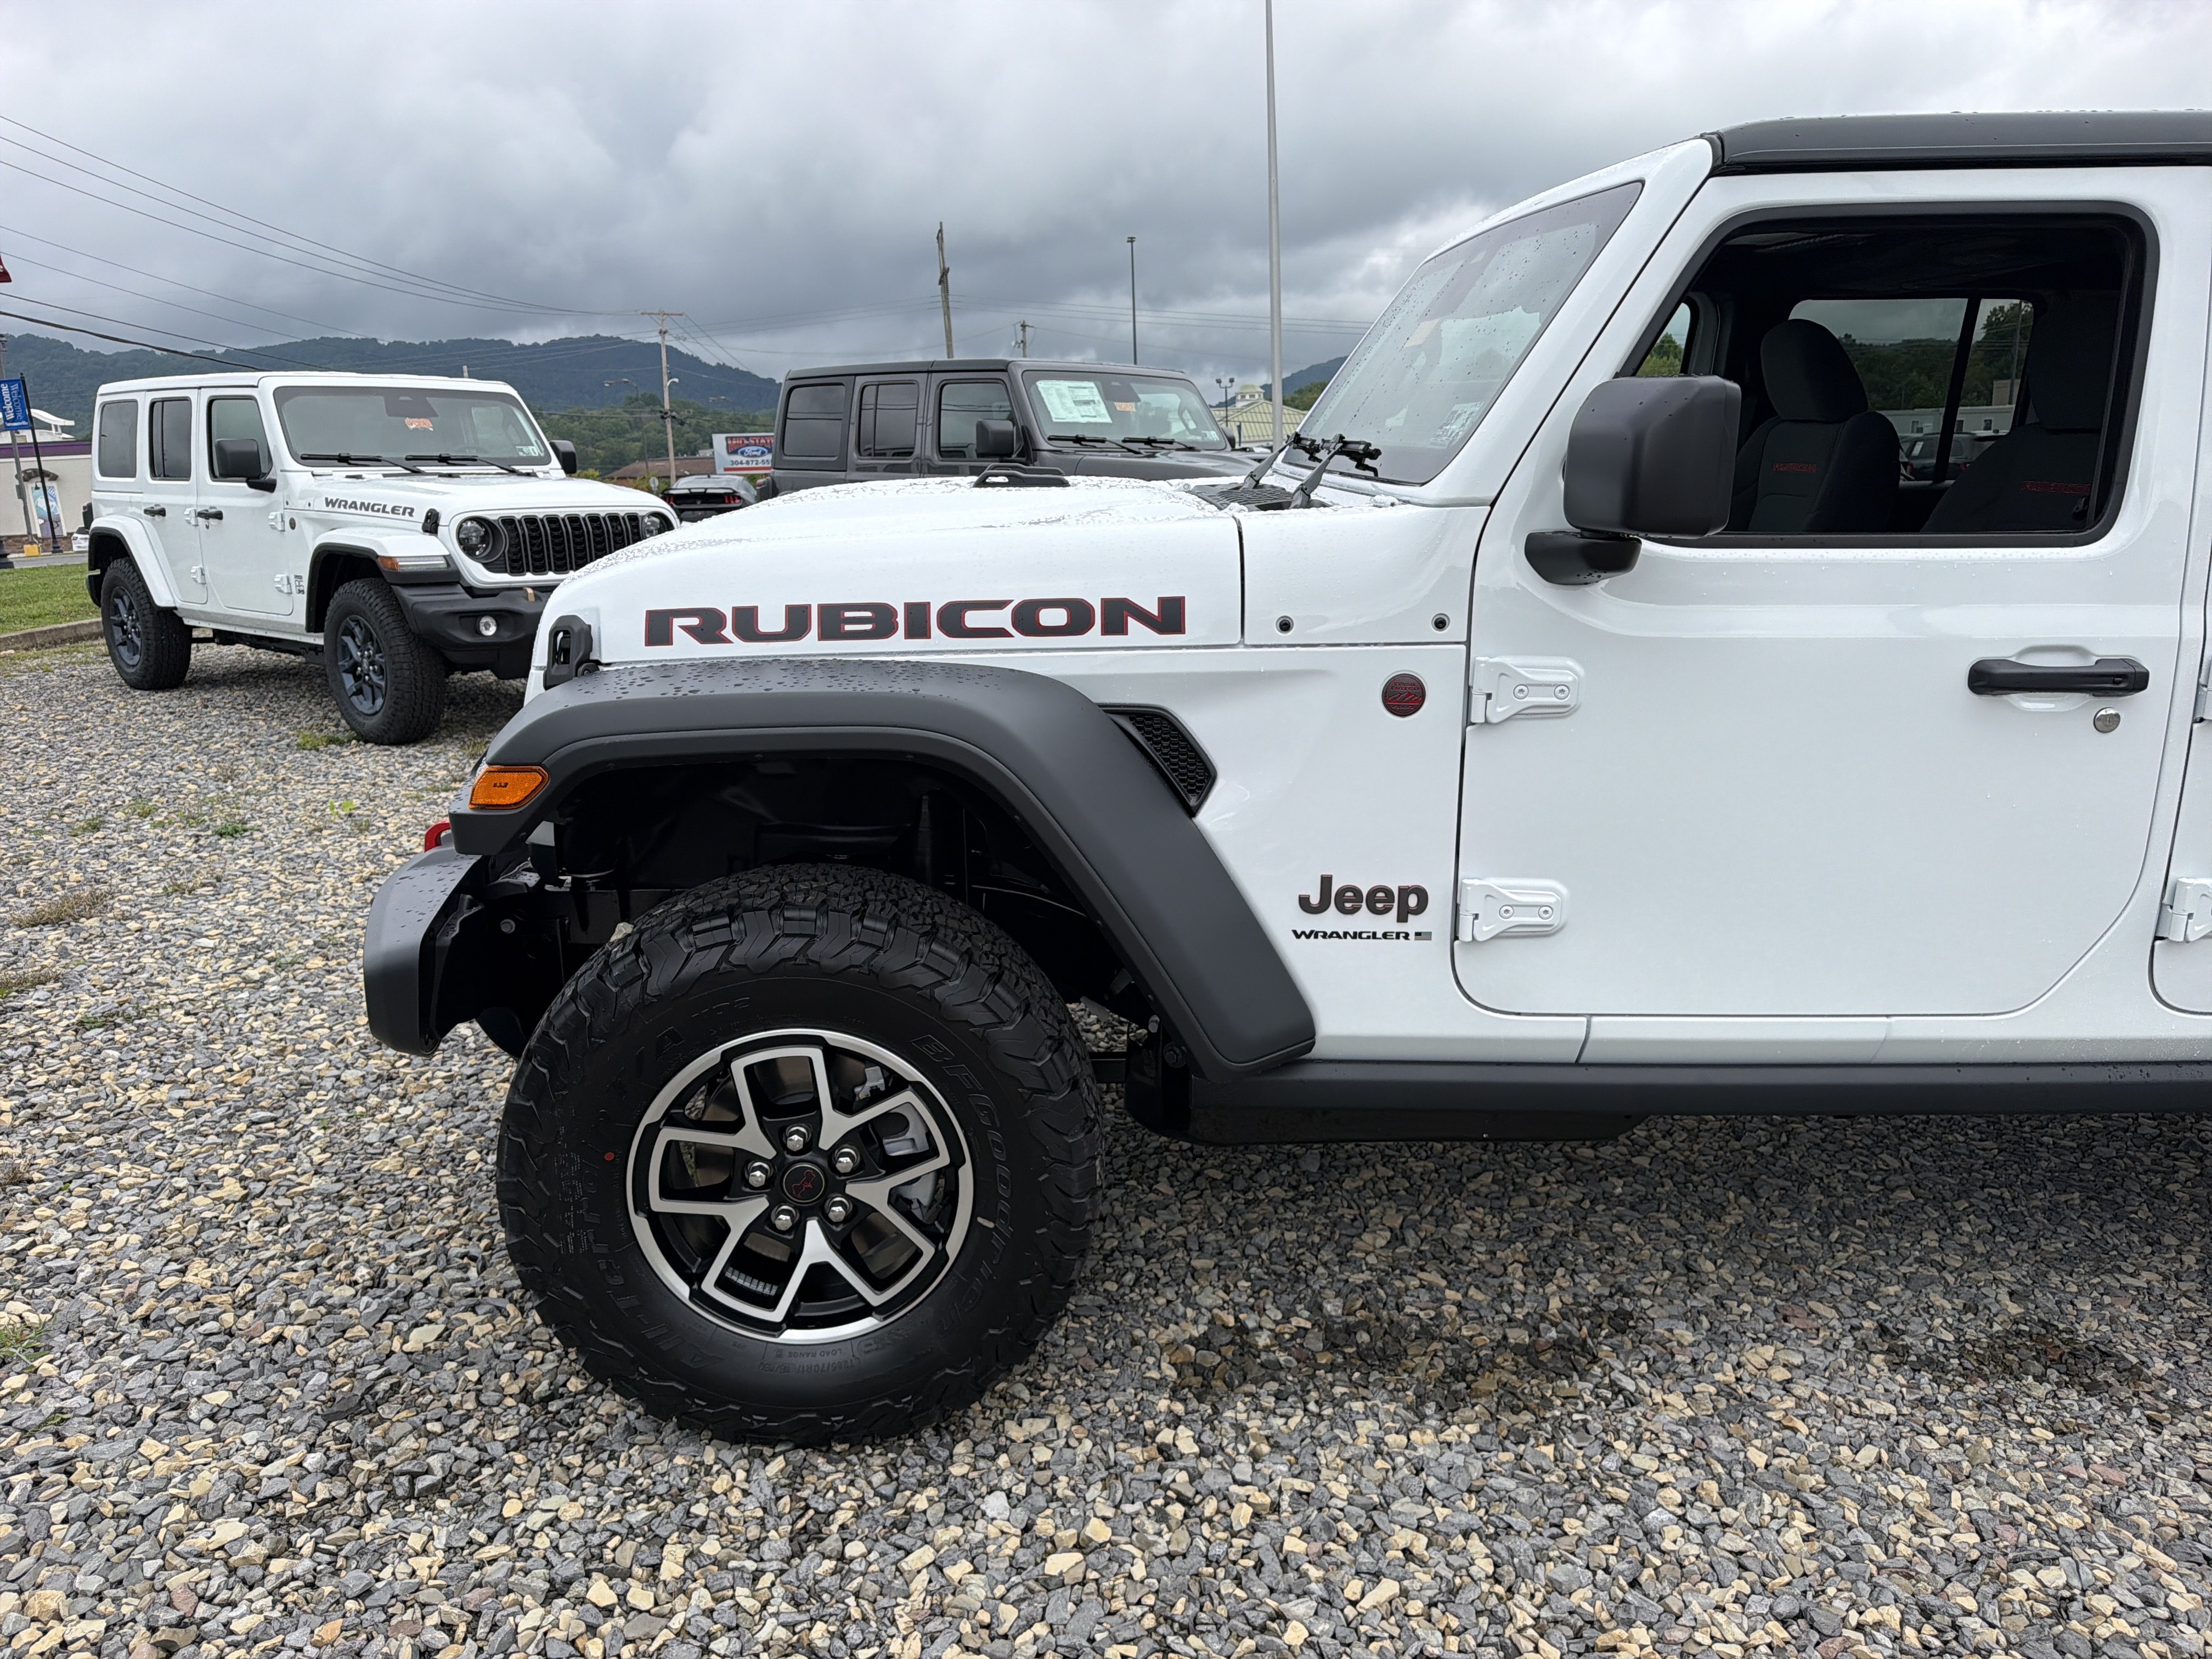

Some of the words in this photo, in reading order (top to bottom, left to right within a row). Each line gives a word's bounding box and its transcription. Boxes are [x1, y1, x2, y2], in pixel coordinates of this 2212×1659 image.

[1, 383, 15, 420] Welcome
[325, 496, 415, 517] WRANGLER
[645, 596, 1186, 647] RUBICON
[1298, 874, 1429, 923] Jeep
[1291, 929, 1410, 940] WRANGLER
[820, 1348, 842, 1357] LOAD
